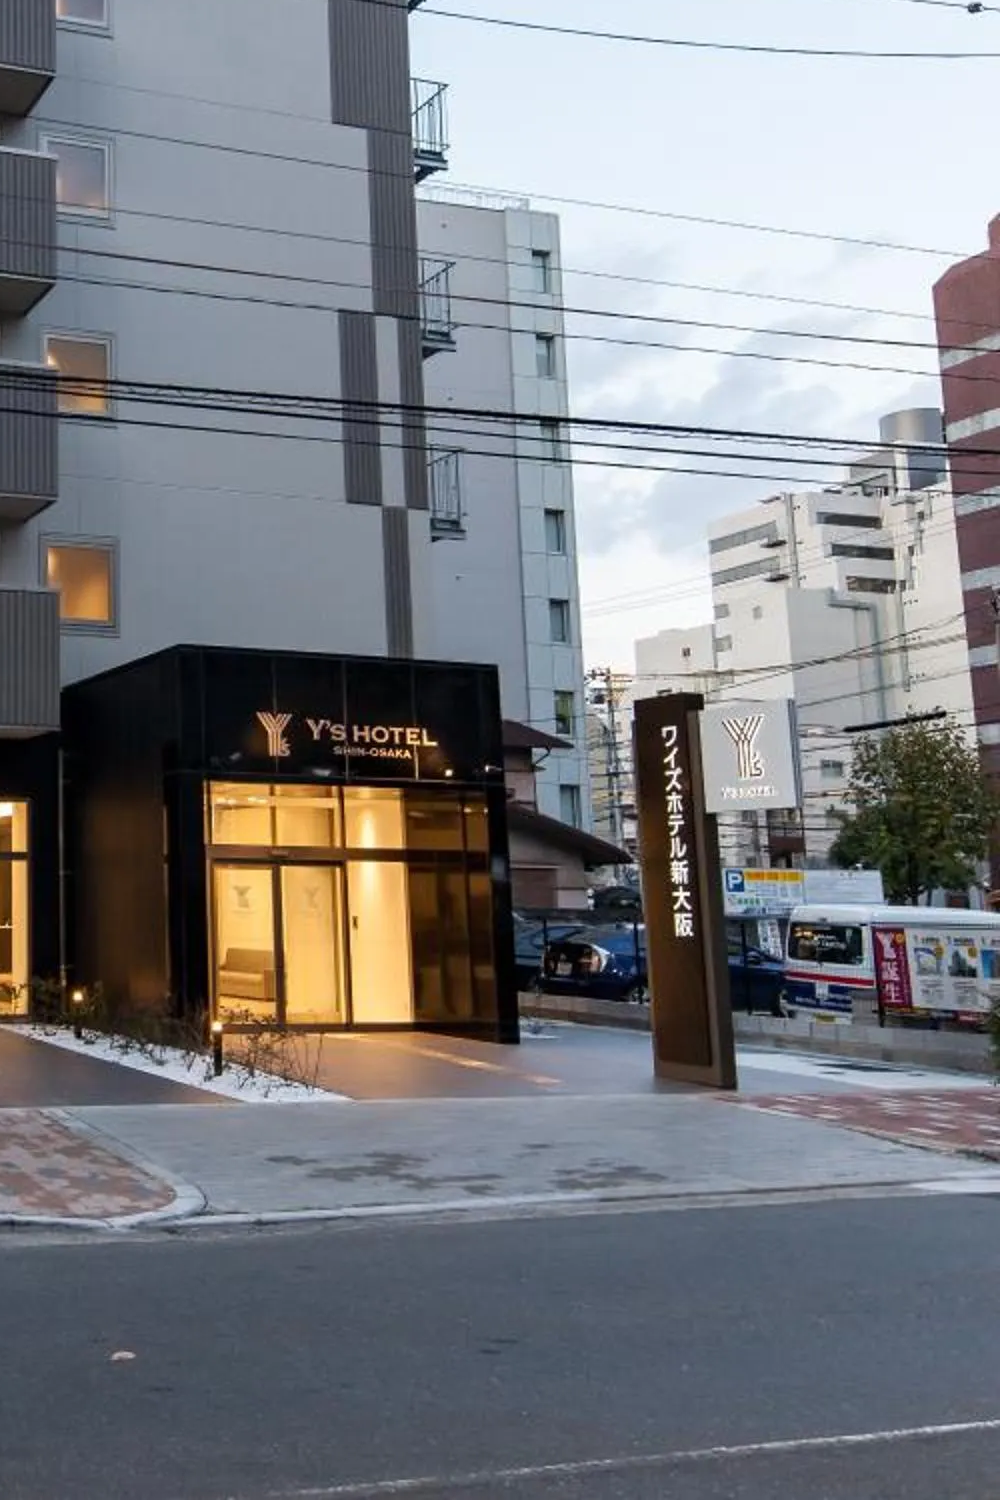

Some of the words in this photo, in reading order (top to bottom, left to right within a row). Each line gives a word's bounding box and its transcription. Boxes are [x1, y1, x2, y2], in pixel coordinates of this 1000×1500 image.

[353, 725, 439, 747] HOTEL
[333, 745, 412, 759] SHIN-OSAKA
[661, 725, 694, 937] ワイズホテル新大阪
